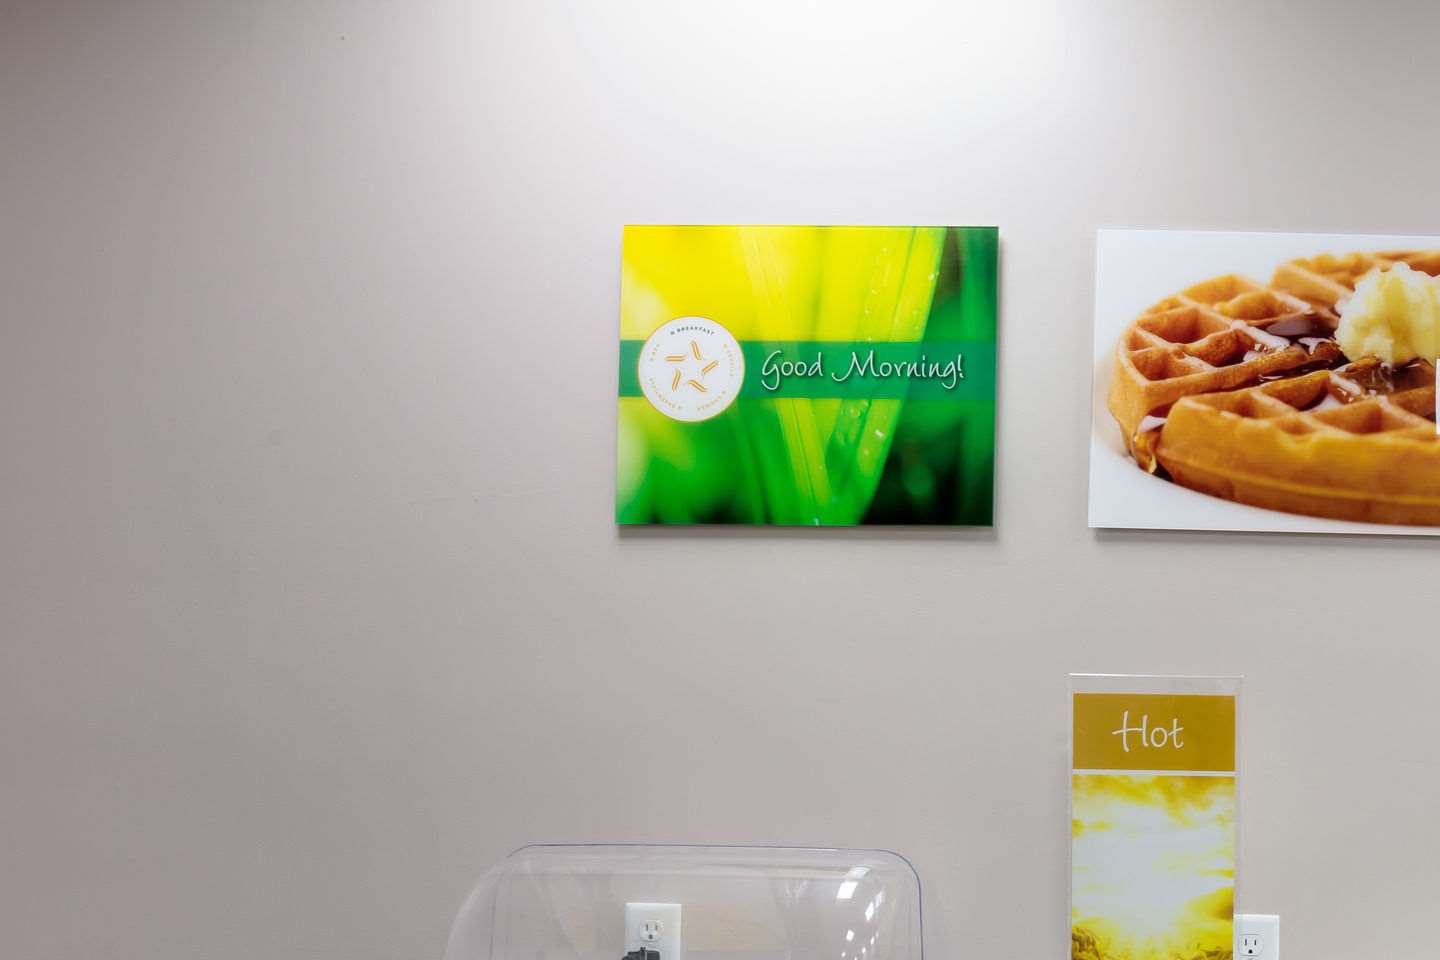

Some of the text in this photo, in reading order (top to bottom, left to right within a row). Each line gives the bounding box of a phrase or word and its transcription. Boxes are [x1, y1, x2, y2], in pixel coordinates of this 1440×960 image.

[761, 350, 824, 390] Good
[831, 350, 964, 389] Morning!
[1112, 710, 1184, 752] Hot
